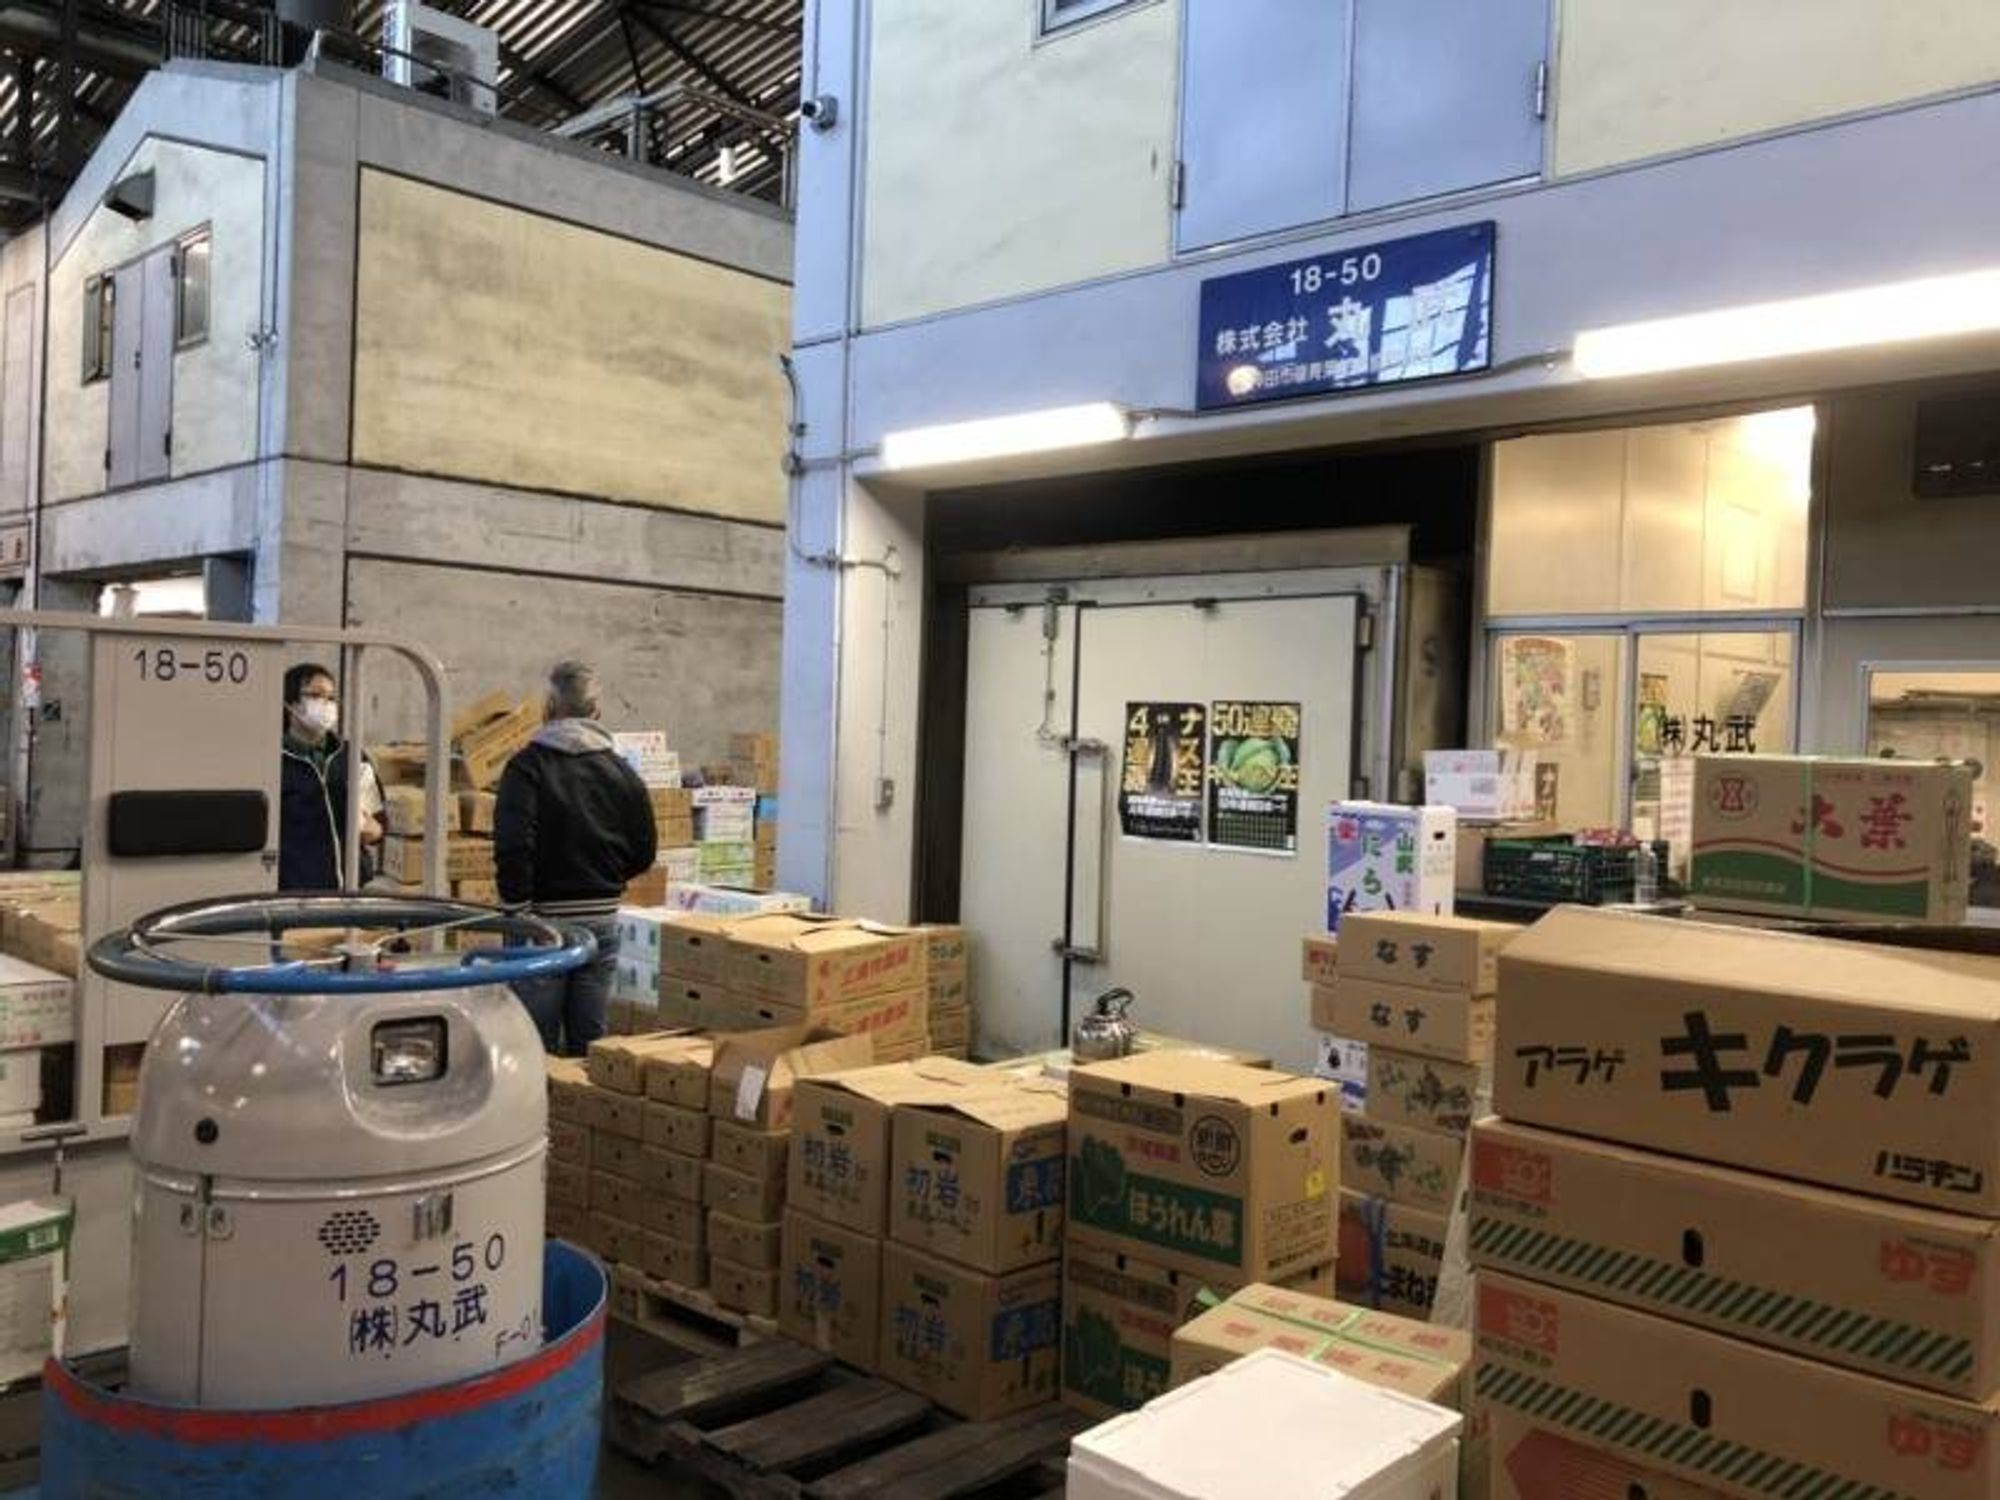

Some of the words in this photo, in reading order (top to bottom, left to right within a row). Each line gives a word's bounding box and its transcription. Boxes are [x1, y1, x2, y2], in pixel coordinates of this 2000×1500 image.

[1289, 252, 1382, 296] 18-50
[1216, 317, 1309, 356] 株式会社
[133, 648, 249, 684] 18-50
[1175, 707, 1202, 796] ナス王
[1362, 834, 1382, 894] にら
[1376, 938, 1434, 968] なす
[1370, 1002, 1425, 1033] なす
[1516, 1044, 1626, 1088] アラゲ
[1659, 1010, 1971, 1112] キクラゲ
[329, 1233, 505, 1302] 18-50
[1879, 1240, 1976, 1295] ゆず
[350, 1284, 488, 1354] (株)丸武
[1887, 1412, 1984, 1471] ゆず
